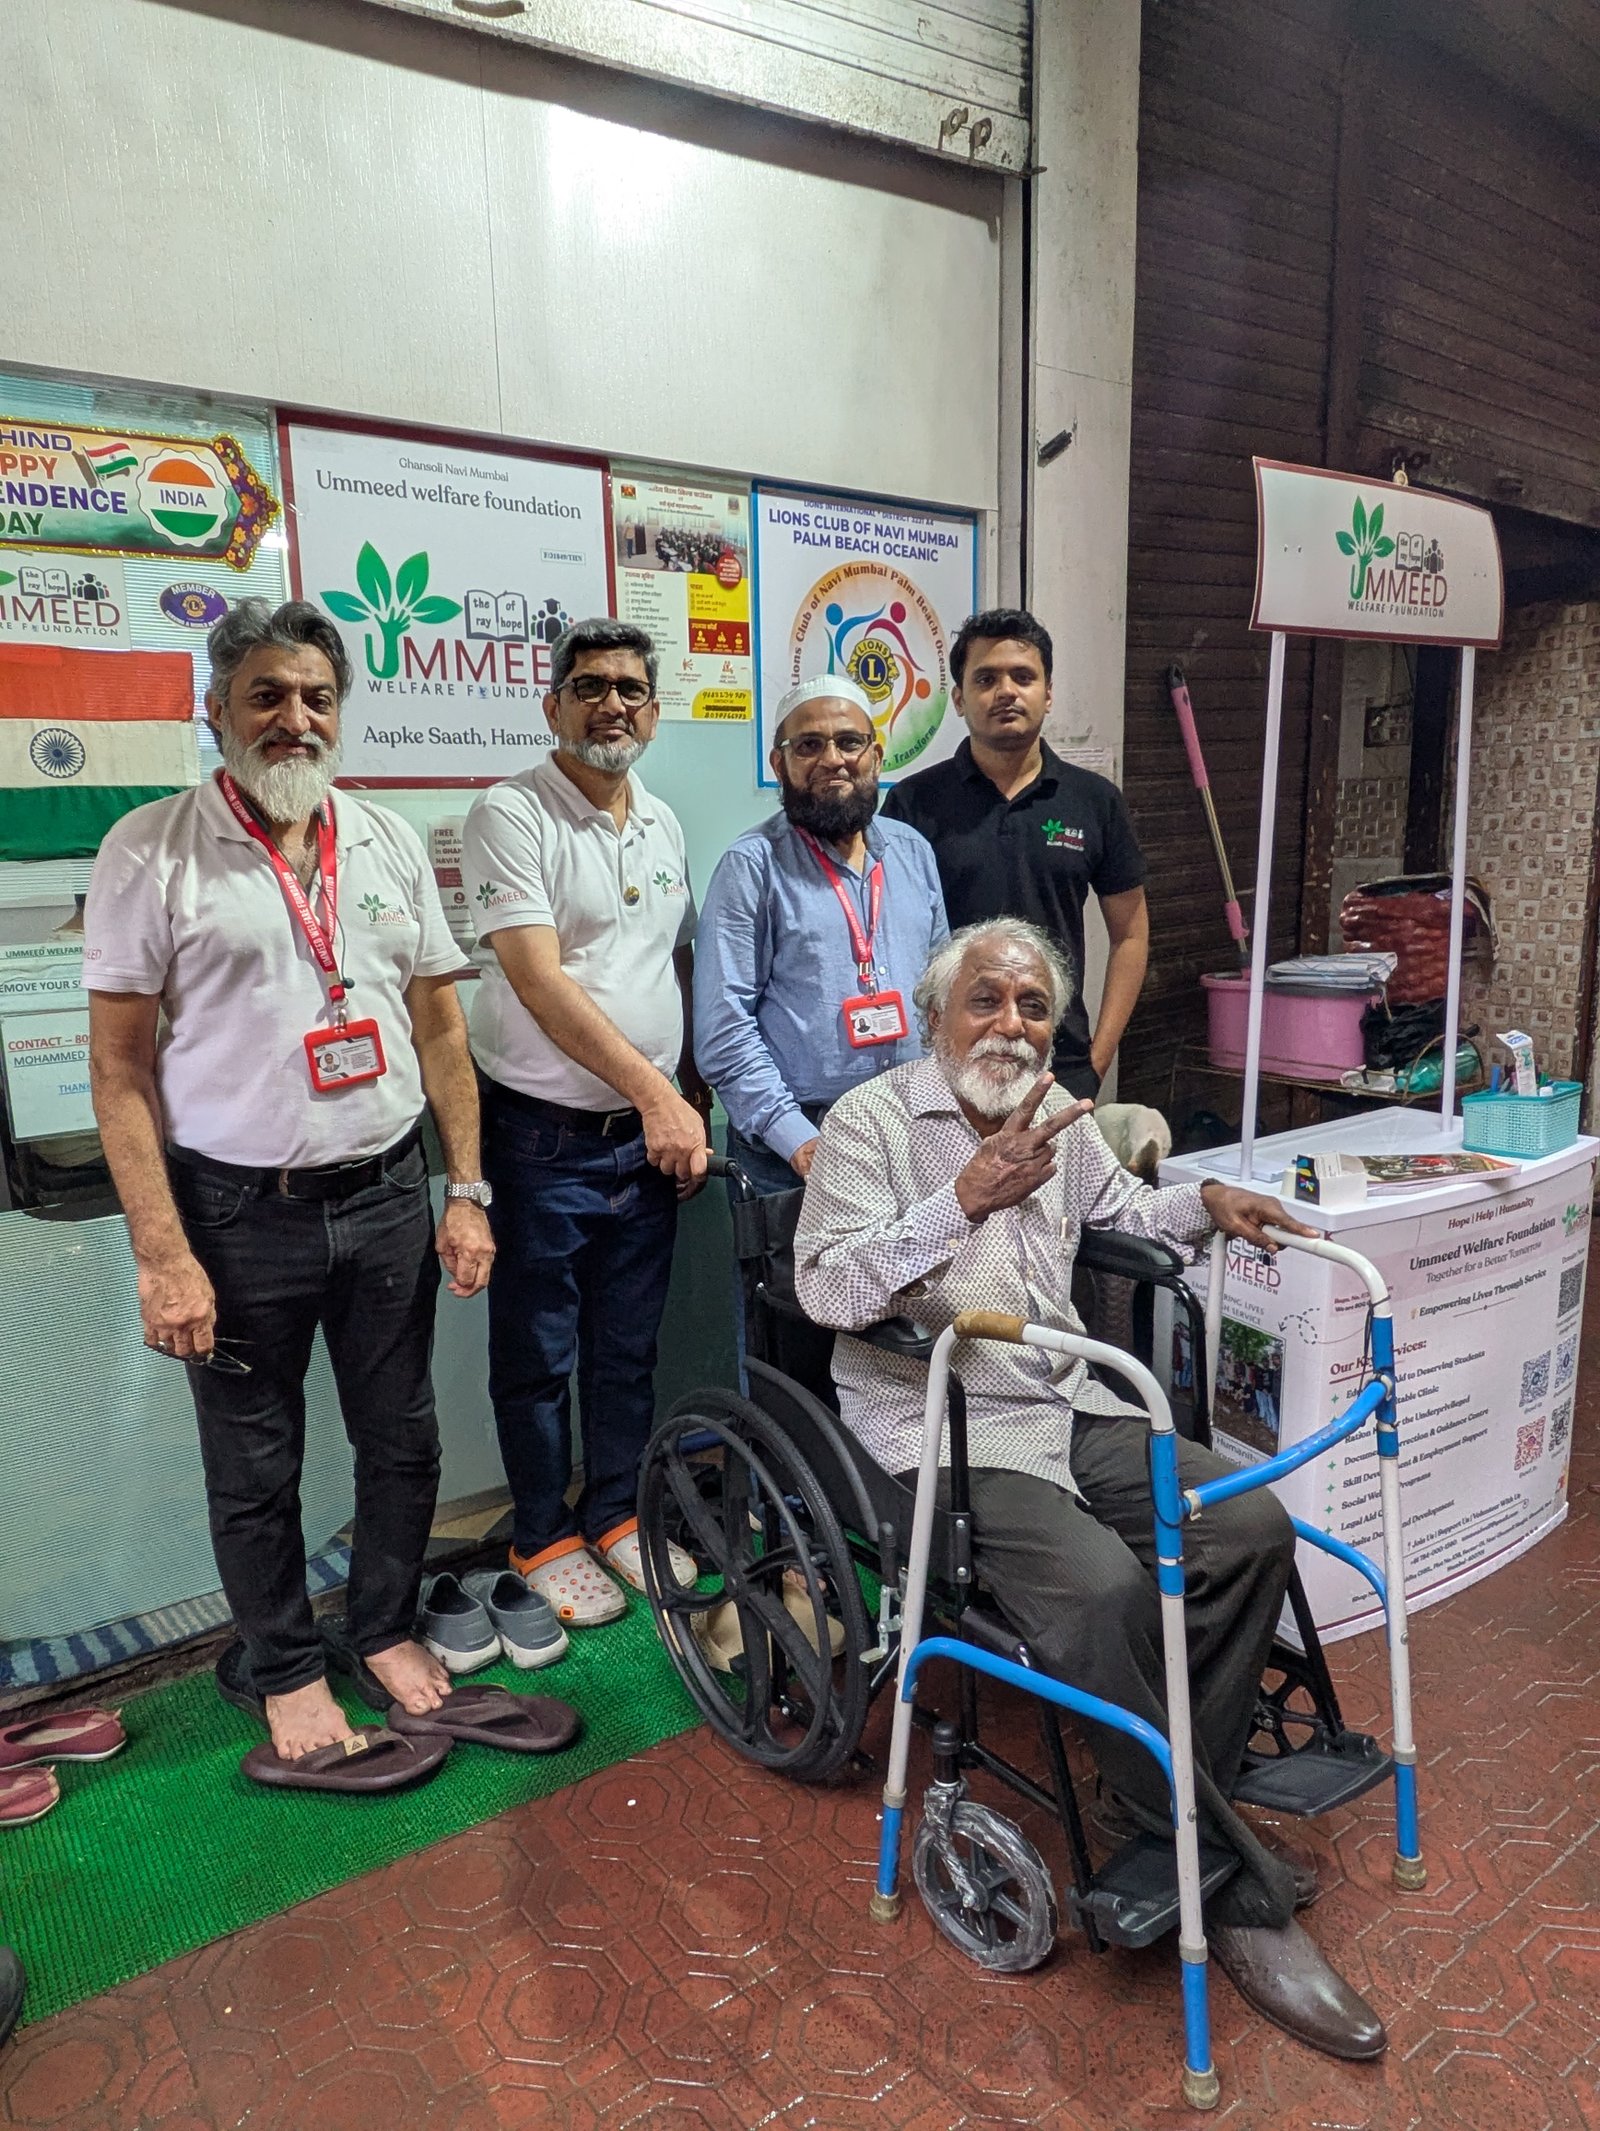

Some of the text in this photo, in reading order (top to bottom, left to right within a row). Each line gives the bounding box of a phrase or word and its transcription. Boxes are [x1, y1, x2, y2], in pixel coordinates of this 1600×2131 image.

[0, 453, 58, 480] PPY
[399, 457, 509, 482] Ghansoli Navi Mumbai
[0, 481, 128, 514] NDENCE
[159, 489, 207, 508] INDIA
[316, 469, 581, 519] Ummeed welfare foundation
[825, 503, 876, 518] INTERNATIONAL
[768, 508, 959, 549] LIONS CLUB OF NAVI MUMBAI
[793, 530, 939, 562] PALM BEACH OCEANIC
[170, 583, 216, 599] MEMBER
[1350, 564, 1448, 607] UMMEED
[473, 597, 516, 611] the of
[1347, 600, 1386, 614] WELFARE
[476, 617, 522, 632] ray hope
[791, 563, 948, 695] Lions Club of Navi Mumbai Palm Beach Oceanic
[364, 634, 552, 686] UMMEE
[858, 640, 889, 656] LIONS
[867, 658, 881, 681] L
[367, 680, 456, 696] WELFARE
[362, 725, 425, 749] Aapke
[428, 726, 487, 748] Saath,
[892, 724, 937, 764] Transform
[434, 828, 454, 837] FREE
[482, 889, 529, 910] UMMEED
[5, 948, 45, 958] UMMEED
[39, 980, 70, 990] YOUR
[8, 1034, 89, 1051] CONTACT 80
[13, 1050, 86, 1066] MOHAMMED
[1448, 1196, 1535, 1230] Hope Help Humanity
[1409, 1217, 1556, 1271] Ummeed Welfare Foundation
[1226, 1254, 1281, 1288] MEED
[1426, 1241, 1542, 1284] Together for a Better Tomorrow
[1419, 1268, 1547, 1317] Empowering Lives Through Service
[1244, 1300, 1265, 1315] LIVES
[1330, 1361, 1355, 1376] Our
[1393, 1340, 1427, 1356] vices:
[1407, 1372, 1415, 1381] to
[1416, 1361, 1454, 1378] Deserving
[1454, 1350, 1486, 1366] Students
[1396, 1384, 1440, 1405] table Clinic
[1402, 1395, 1471, 1426] the Underprivileged
[1344, 1407, 1489, 1466] Docume rrection & Guidance Centre
[1345, 1430, 1371, 1444] Ration
[1343, 1474, 1362, 1488] Skill
[1412, 1456, 1418, 1465] &
[1419, 1440, 1462, 1462] Employment
[1461, 1427, 1488, 1445] Support
[1341, 1495, 1367, 1510] Social
[1401, 1517, 1411, 1528] nd
[1412, 1500, 1455, 1526] Development
[1341, 1512, 1377, 1531] Legal Aid
